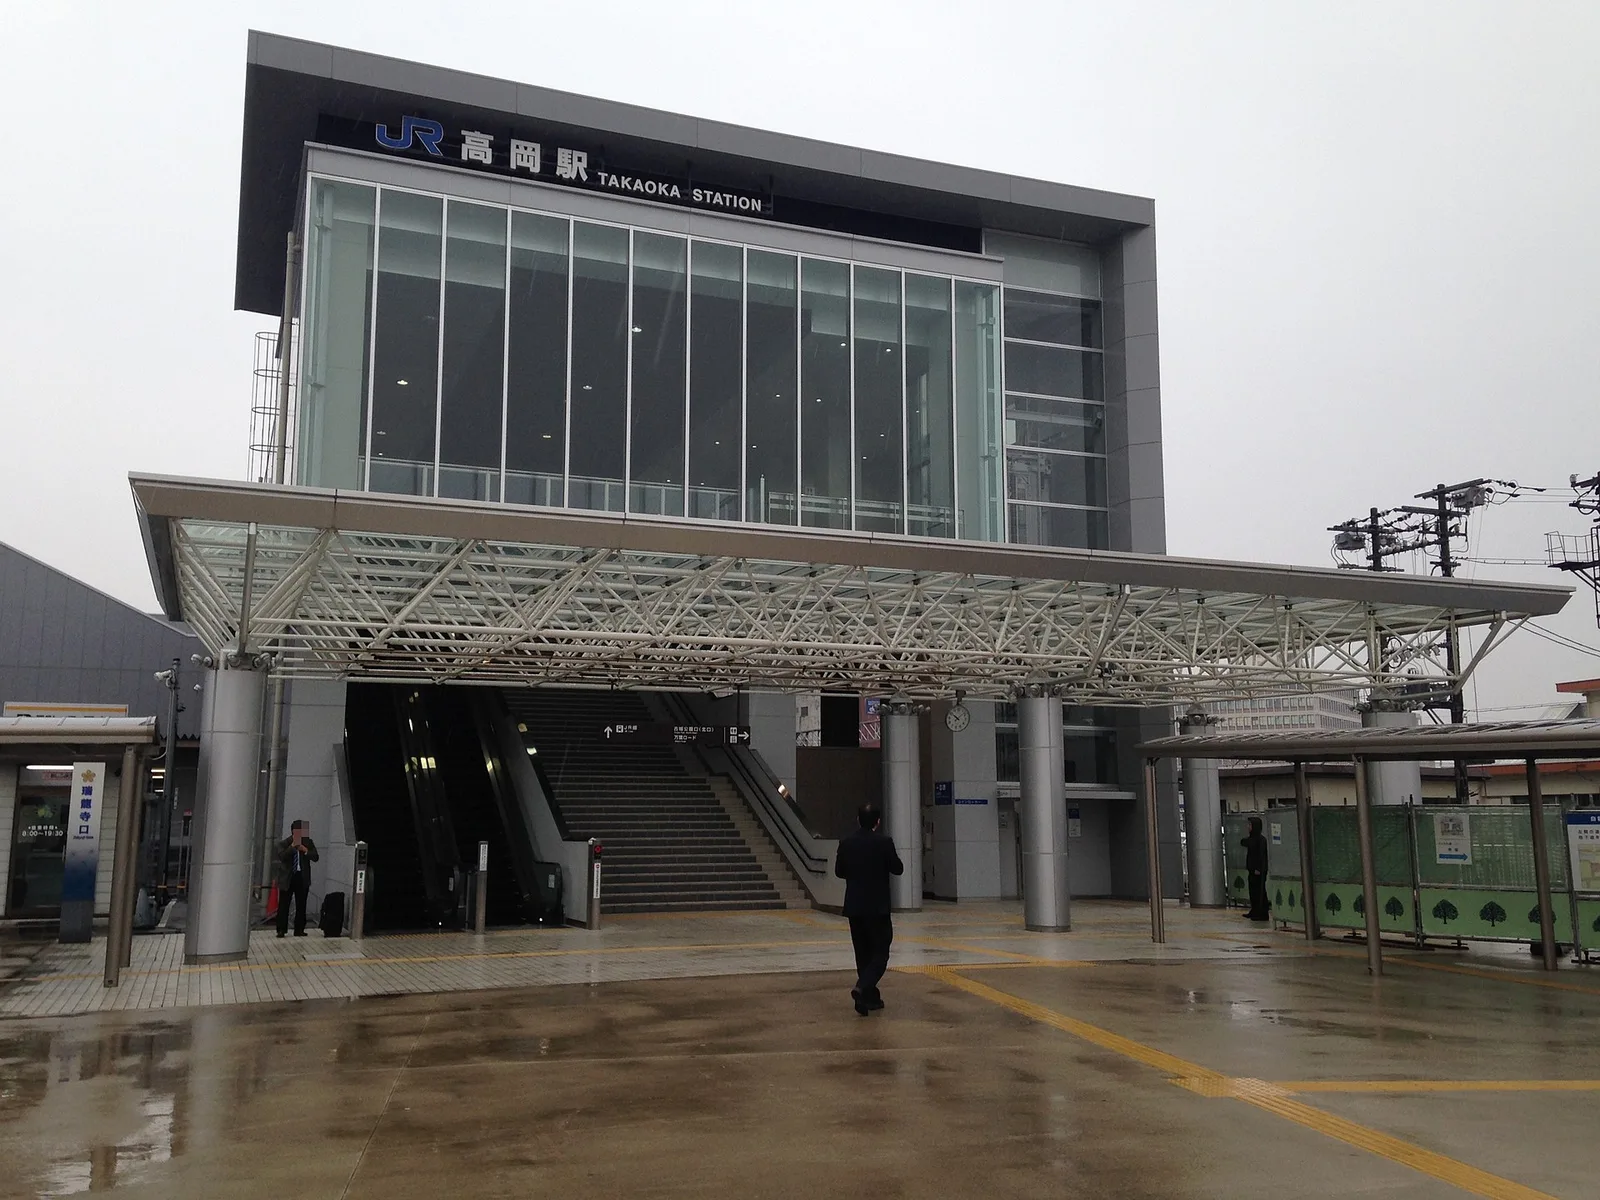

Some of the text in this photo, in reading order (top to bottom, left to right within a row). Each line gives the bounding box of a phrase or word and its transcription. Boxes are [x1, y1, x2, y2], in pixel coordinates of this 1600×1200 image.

[375, 115, 762, 212] JR 高岡駅 TAKAOKA STATION
